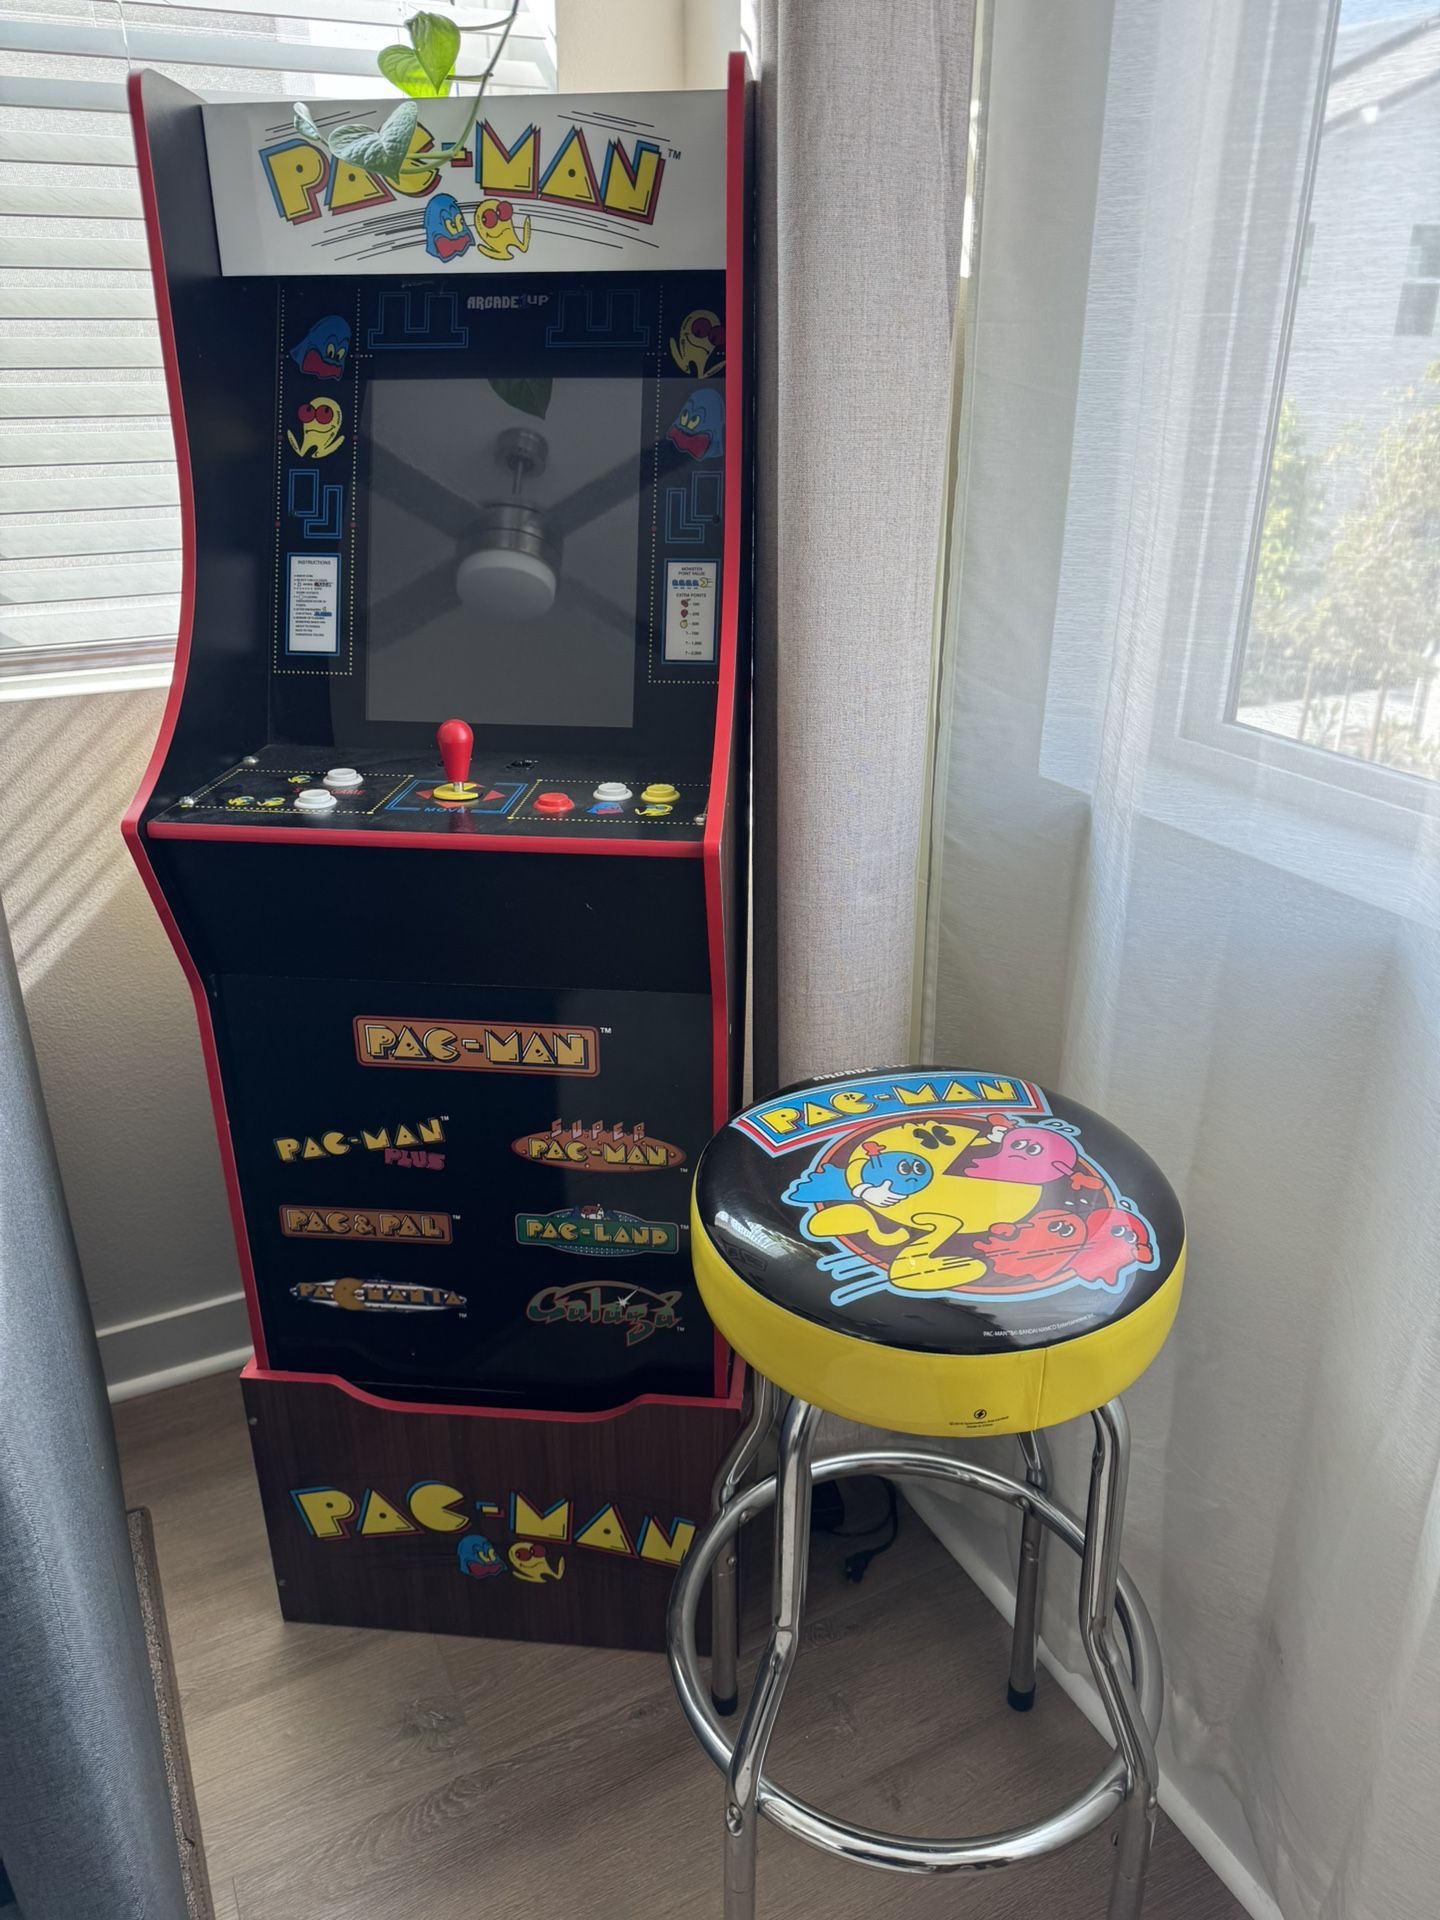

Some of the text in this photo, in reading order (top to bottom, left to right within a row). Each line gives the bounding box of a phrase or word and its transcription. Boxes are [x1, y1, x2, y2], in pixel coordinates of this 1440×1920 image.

[258, 117, 666, 225] PAC-MAN
[364, 1024, 589, 1069] PAC-MAN
[757, 1080, 1018, 1134] PAC-MAN
[273, 1117, 446, 1163] PAC-MAN
[551, 1118, 645, 1142] SUPER
[384, 1148, 446, 1171] PLUS
[528, 1138, 669, 1166] PAC-MAN
[287, 1209, 350, 1234] PAC
[354, 1214, 377, 1236] &
[380, 1213, 445, 1239] PAL
[526, 1219, 669, 1245] PAC-LAND
[290, 1480, 698, 1568] PAC-MAN
